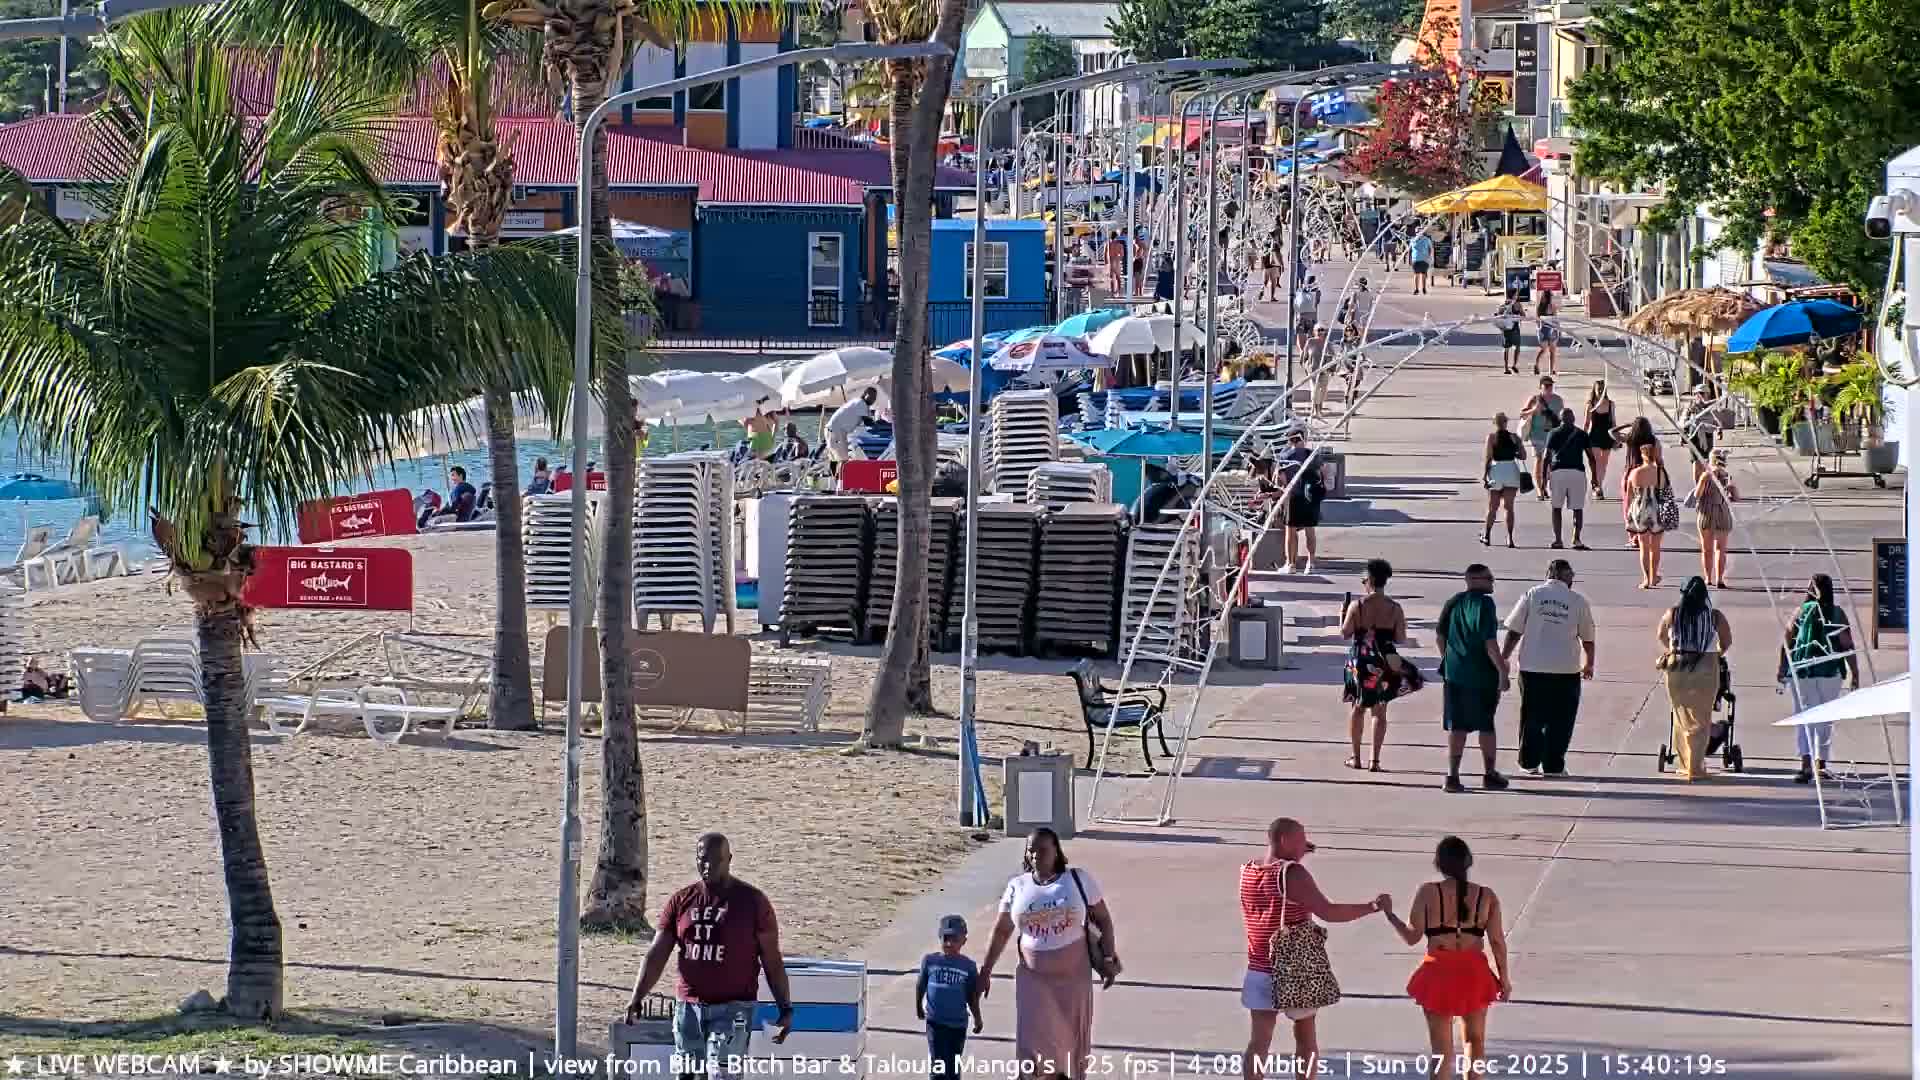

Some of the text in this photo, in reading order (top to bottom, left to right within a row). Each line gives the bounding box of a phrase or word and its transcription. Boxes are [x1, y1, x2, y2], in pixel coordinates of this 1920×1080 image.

[290, 560, 364, 571] BIG BASTARD'S
[690, 906, 727, 922] GET
[694, 924, 714, 940] IT
[684, 943, 726, 961] DONE
